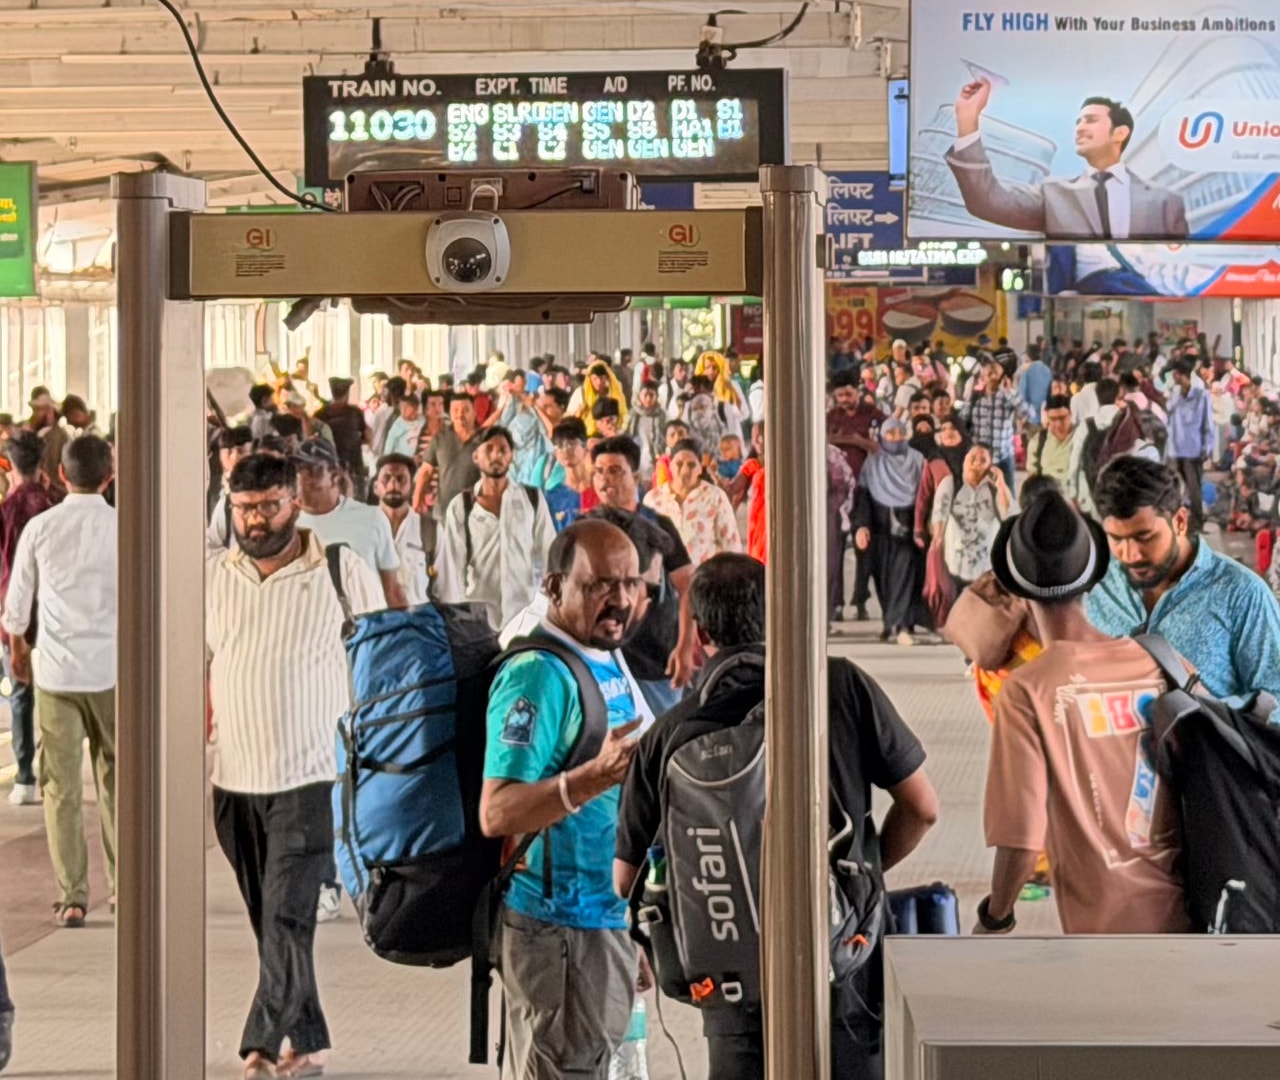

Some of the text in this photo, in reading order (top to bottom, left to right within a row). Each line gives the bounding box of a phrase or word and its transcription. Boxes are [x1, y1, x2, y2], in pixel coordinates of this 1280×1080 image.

[962, 13, 1276, 32] FLY HIGH With Your Business Ambitions
[328, 80, 442, 97] TRAIN NO.
[475, 77, 568, 95] EXPT. TIME
[603, 76, 628, 93] A/D
[668, 74, 716, 92] PF. NO.
[329, 109, 437, 141] 11030
[686, 827, 740, 941] sofari
